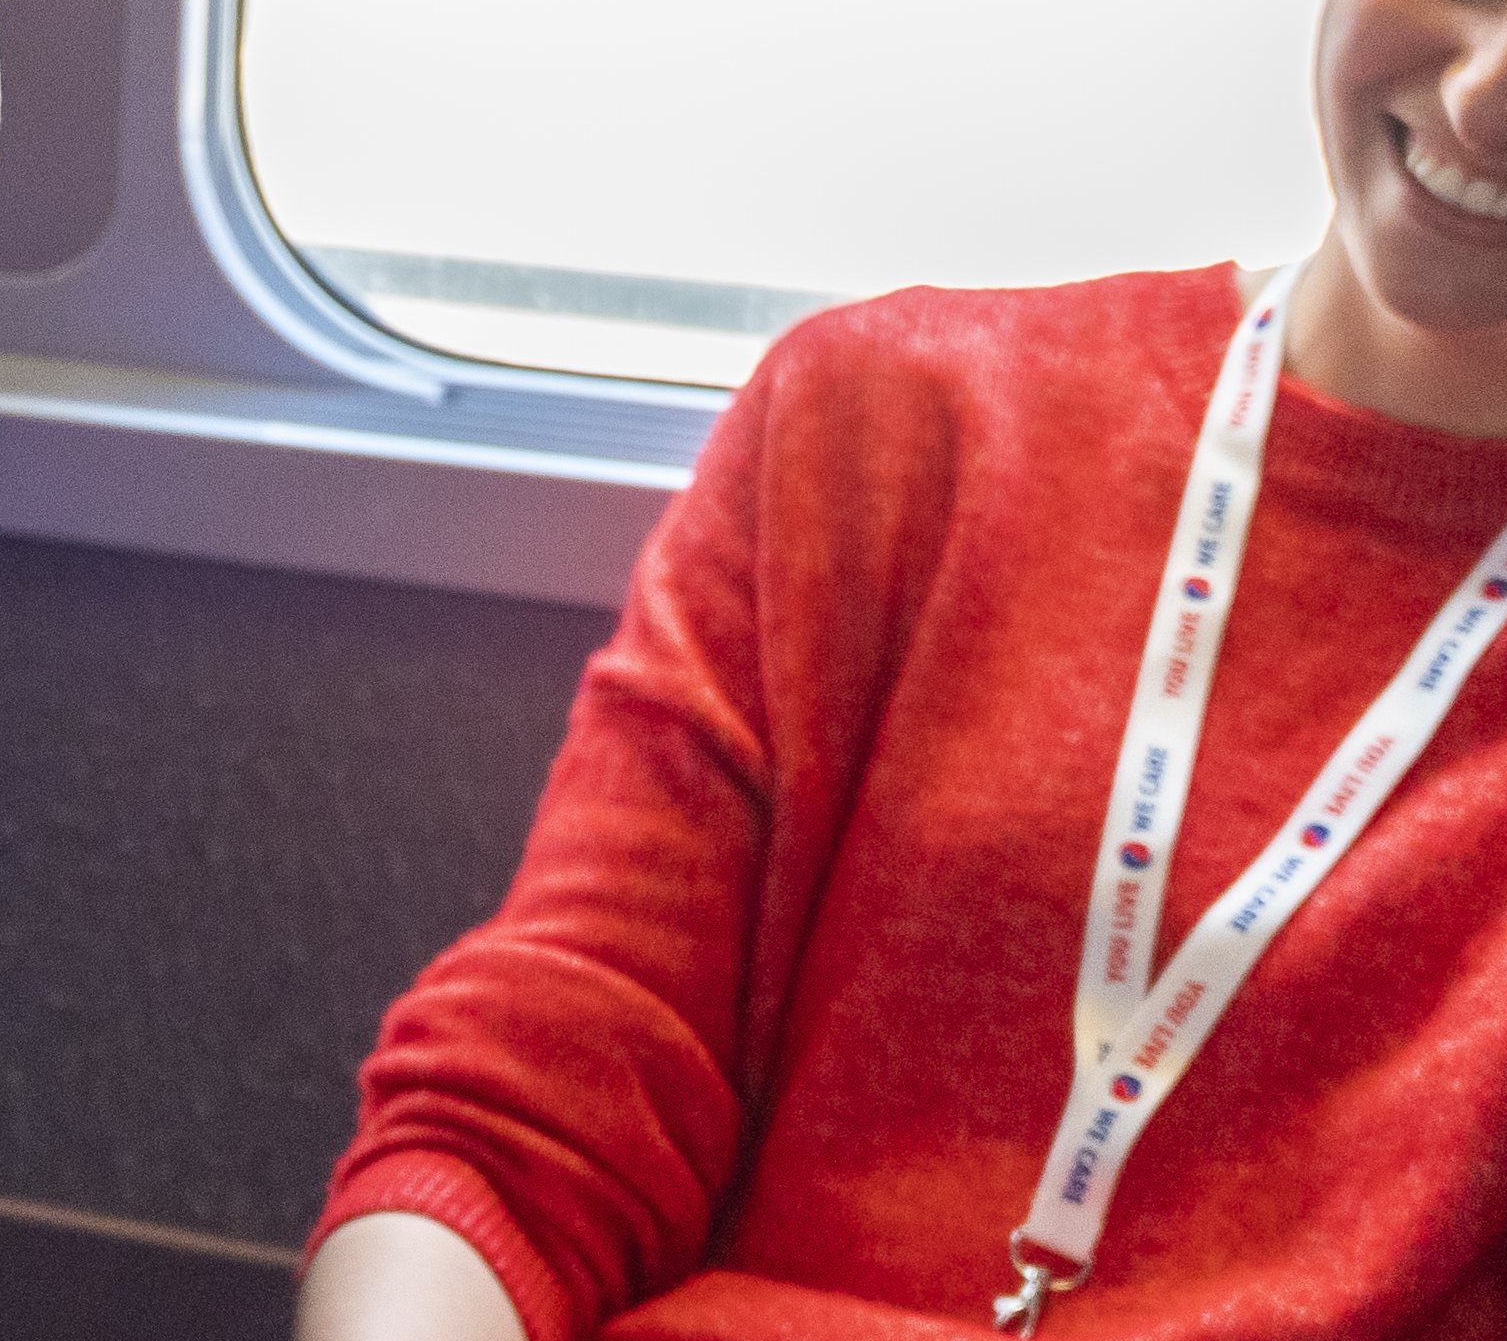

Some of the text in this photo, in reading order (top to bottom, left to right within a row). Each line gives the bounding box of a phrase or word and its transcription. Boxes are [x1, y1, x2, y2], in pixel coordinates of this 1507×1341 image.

[1162, 480, 1232, 698] YOU LIVE WE CARE
[1418, 639, 1459, 691] CARE
[1455, 607, 1485, 635] WE
[1104, 744, 1168, 984] YOU LIVE WE CARE
[1230, 733, 1395, 935] YOU LIVE WE CARE
[1061, 979, 1207, 1206] YOU LIVE WE CARE
